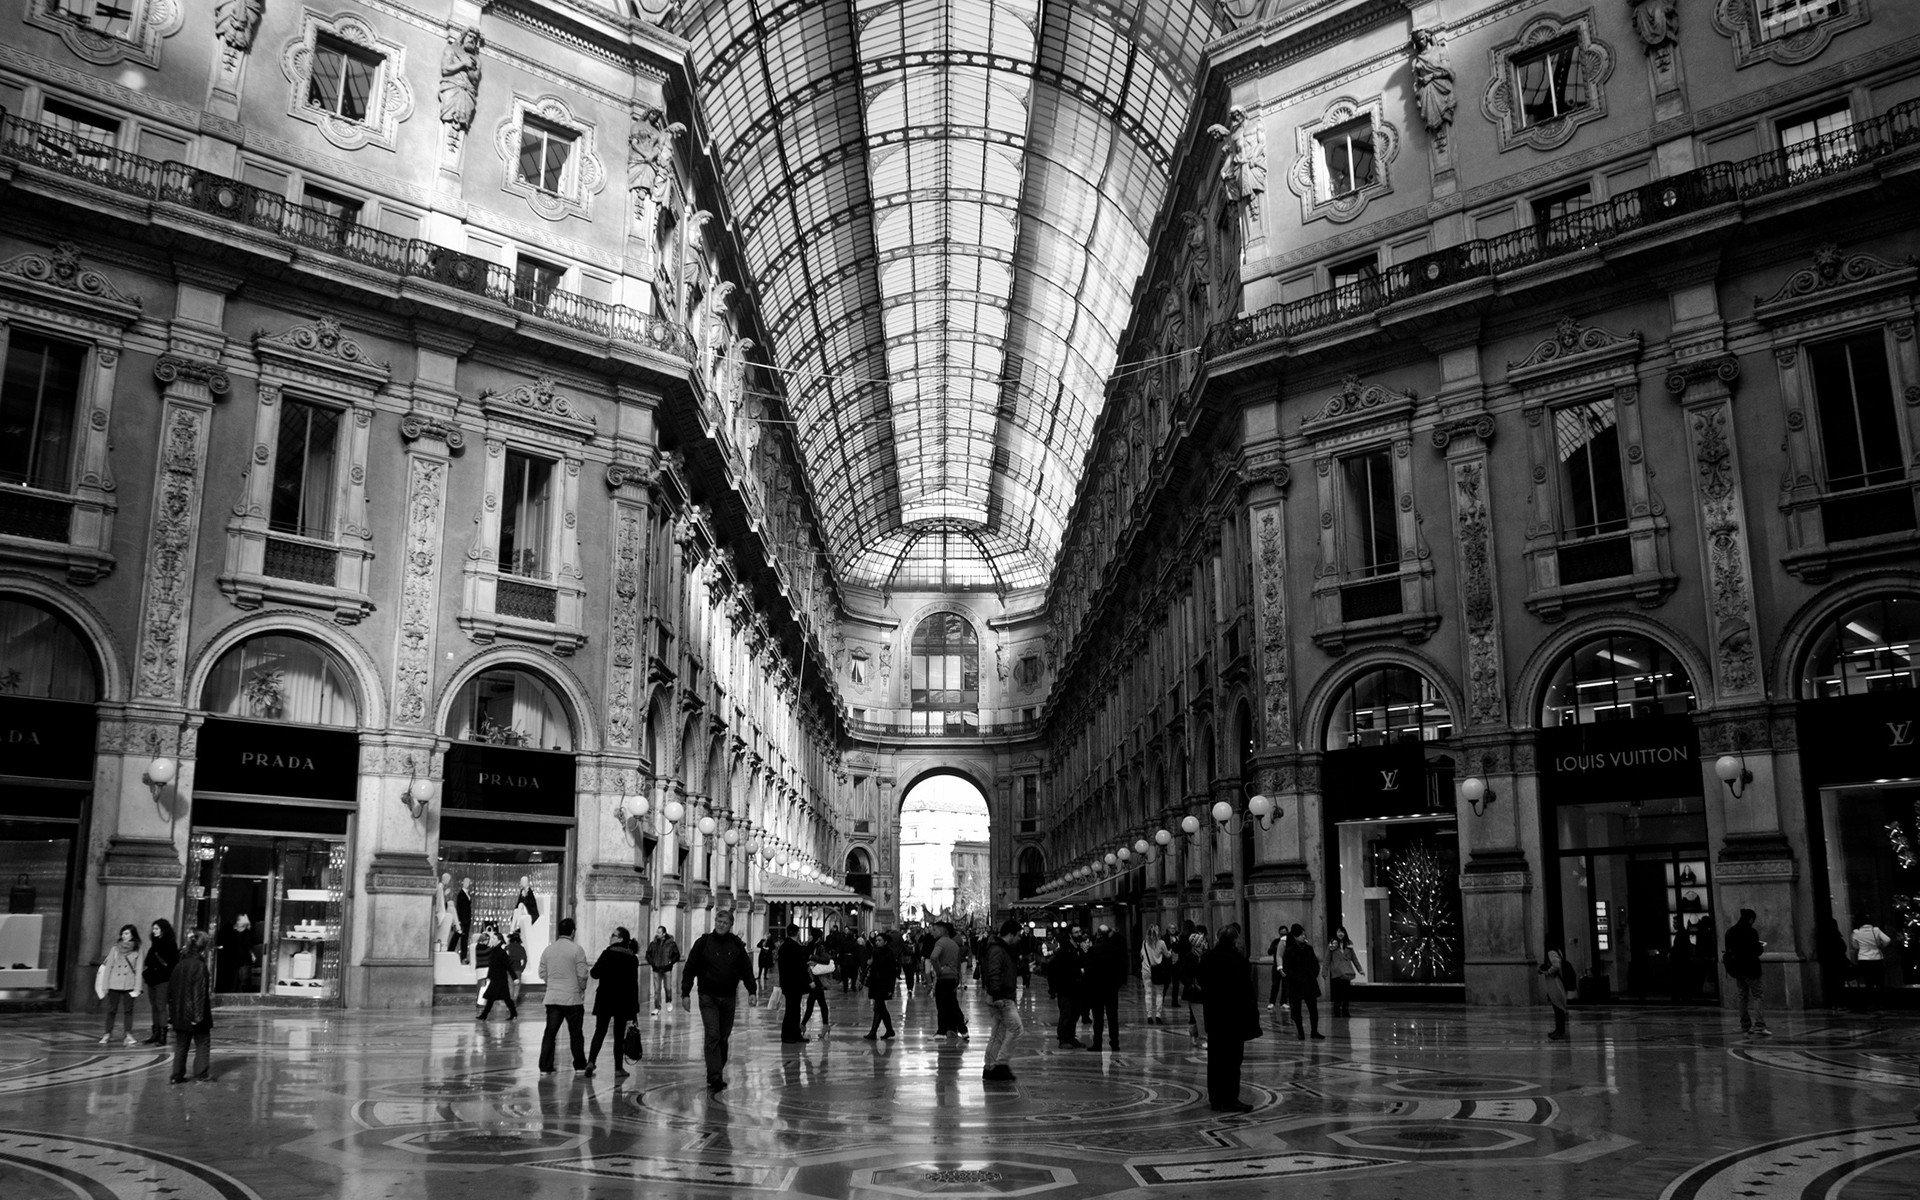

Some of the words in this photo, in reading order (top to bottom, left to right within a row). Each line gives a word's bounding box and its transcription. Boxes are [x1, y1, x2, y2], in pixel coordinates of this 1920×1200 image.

[241, 752, 315, 771] PRADA
[1556, 753, 1605, 772] LOUIS
[1609, 745, 1689, 767] VUITTON
[478, 772, 540, 790] PRADA
